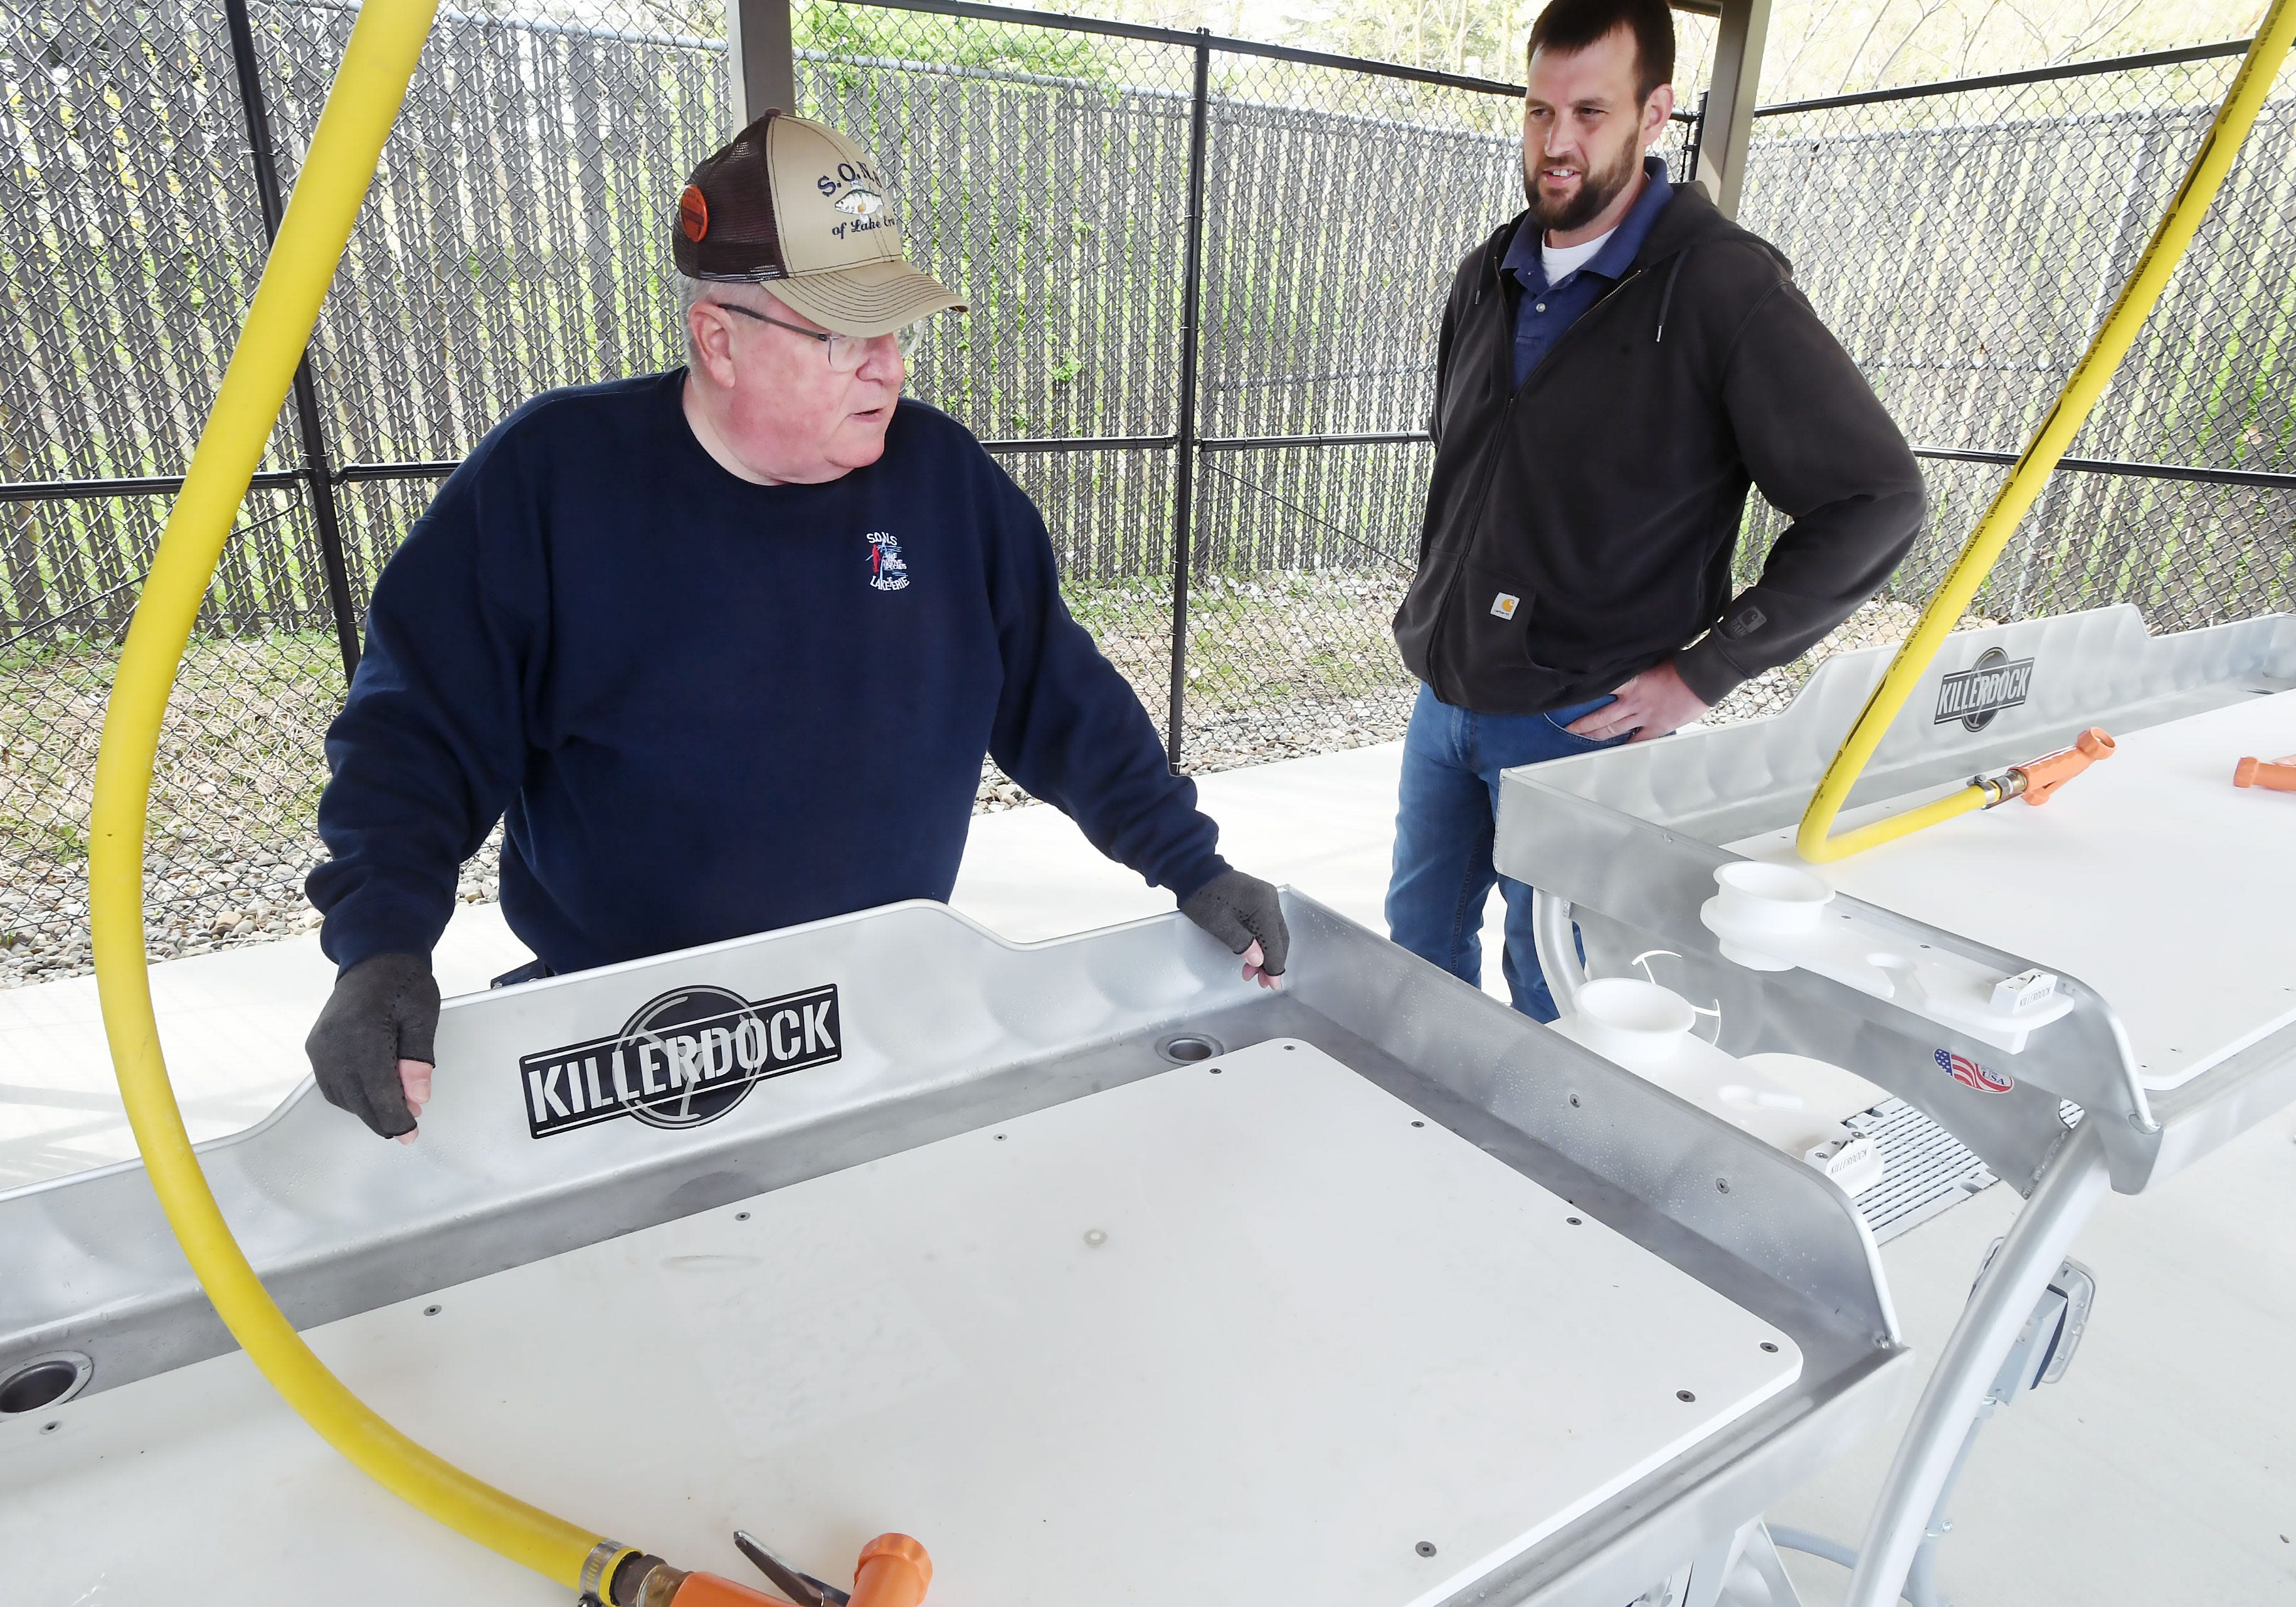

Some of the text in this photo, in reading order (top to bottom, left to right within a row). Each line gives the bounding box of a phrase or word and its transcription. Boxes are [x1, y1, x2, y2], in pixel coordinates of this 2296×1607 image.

[832, 222, 847, 240] of
[850, 218, 881, 233] Lake
[866, 532, 897, 545] SONS
[870, 576, 910, 591] LAKE ERIE
[1937, 667, 2031, 715] KILLERDOCK
[527, 999, 836, 1123] KILLERDOCK
[1982, 1070, 2005, 1085] USA
[1831, 1149, 1867, 1176] KILLERDOCK
